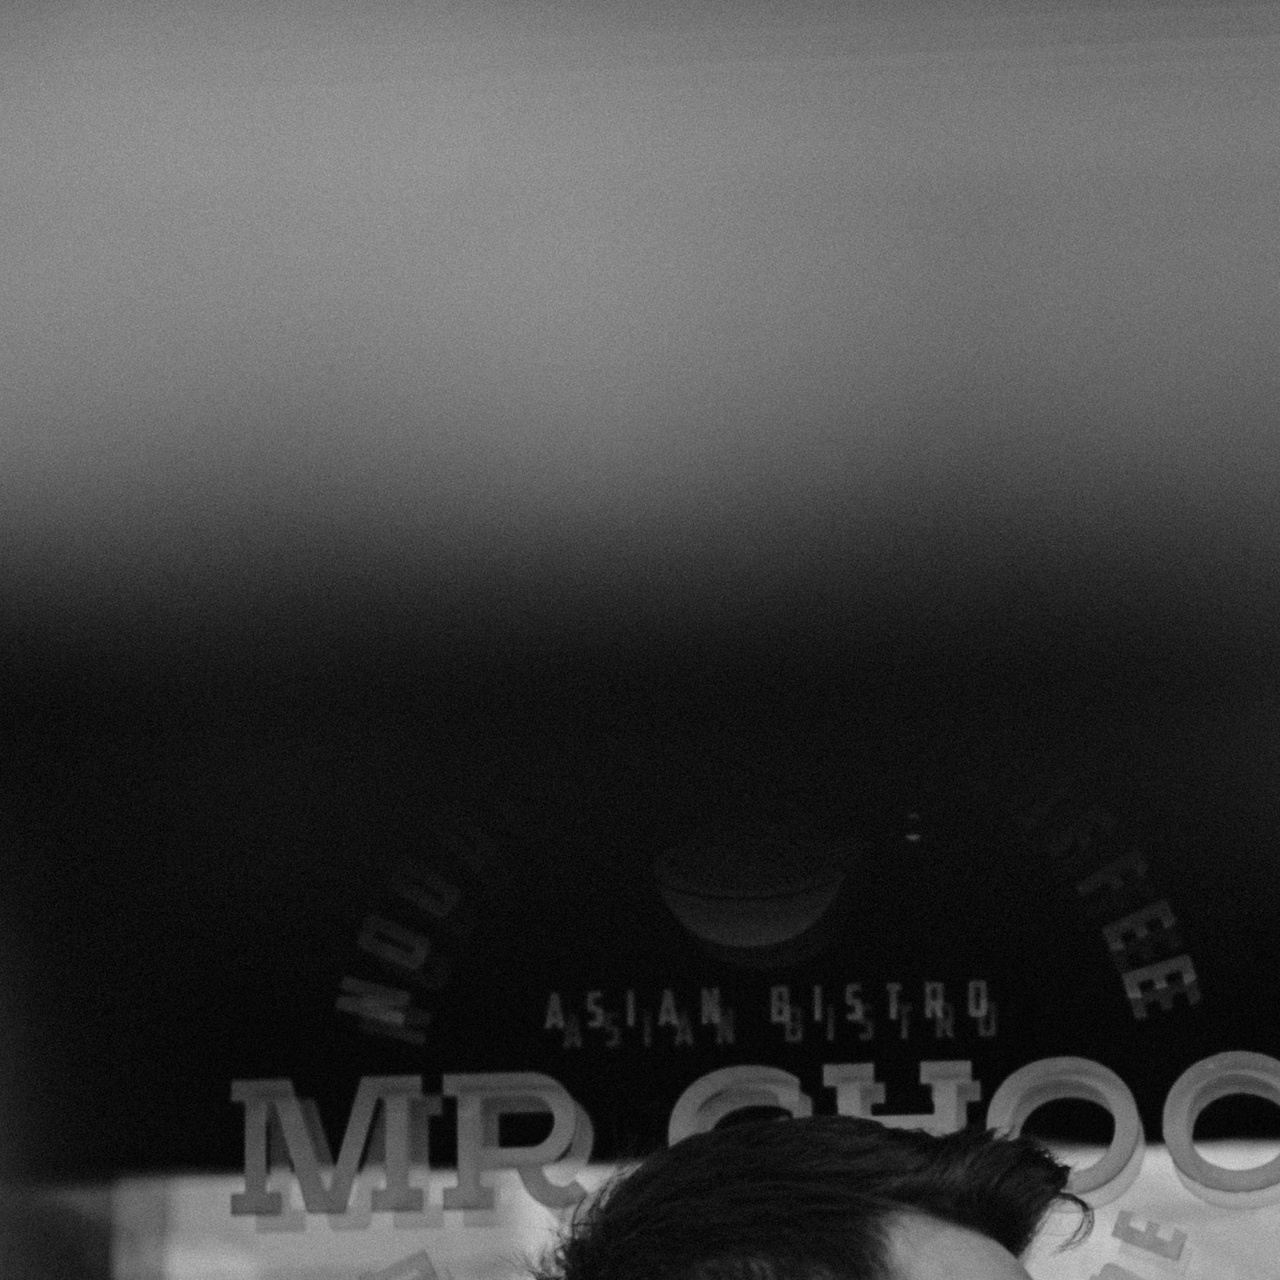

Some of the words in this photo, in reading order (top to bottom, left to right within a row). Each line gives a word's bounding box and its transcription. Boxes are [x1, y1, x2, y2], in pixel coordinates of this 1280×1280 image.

[543, 986, 722, 1032] ASIAN
[767, 978, 990, 1028] BISTRO
[230, 1070, 590, 1217] MR
